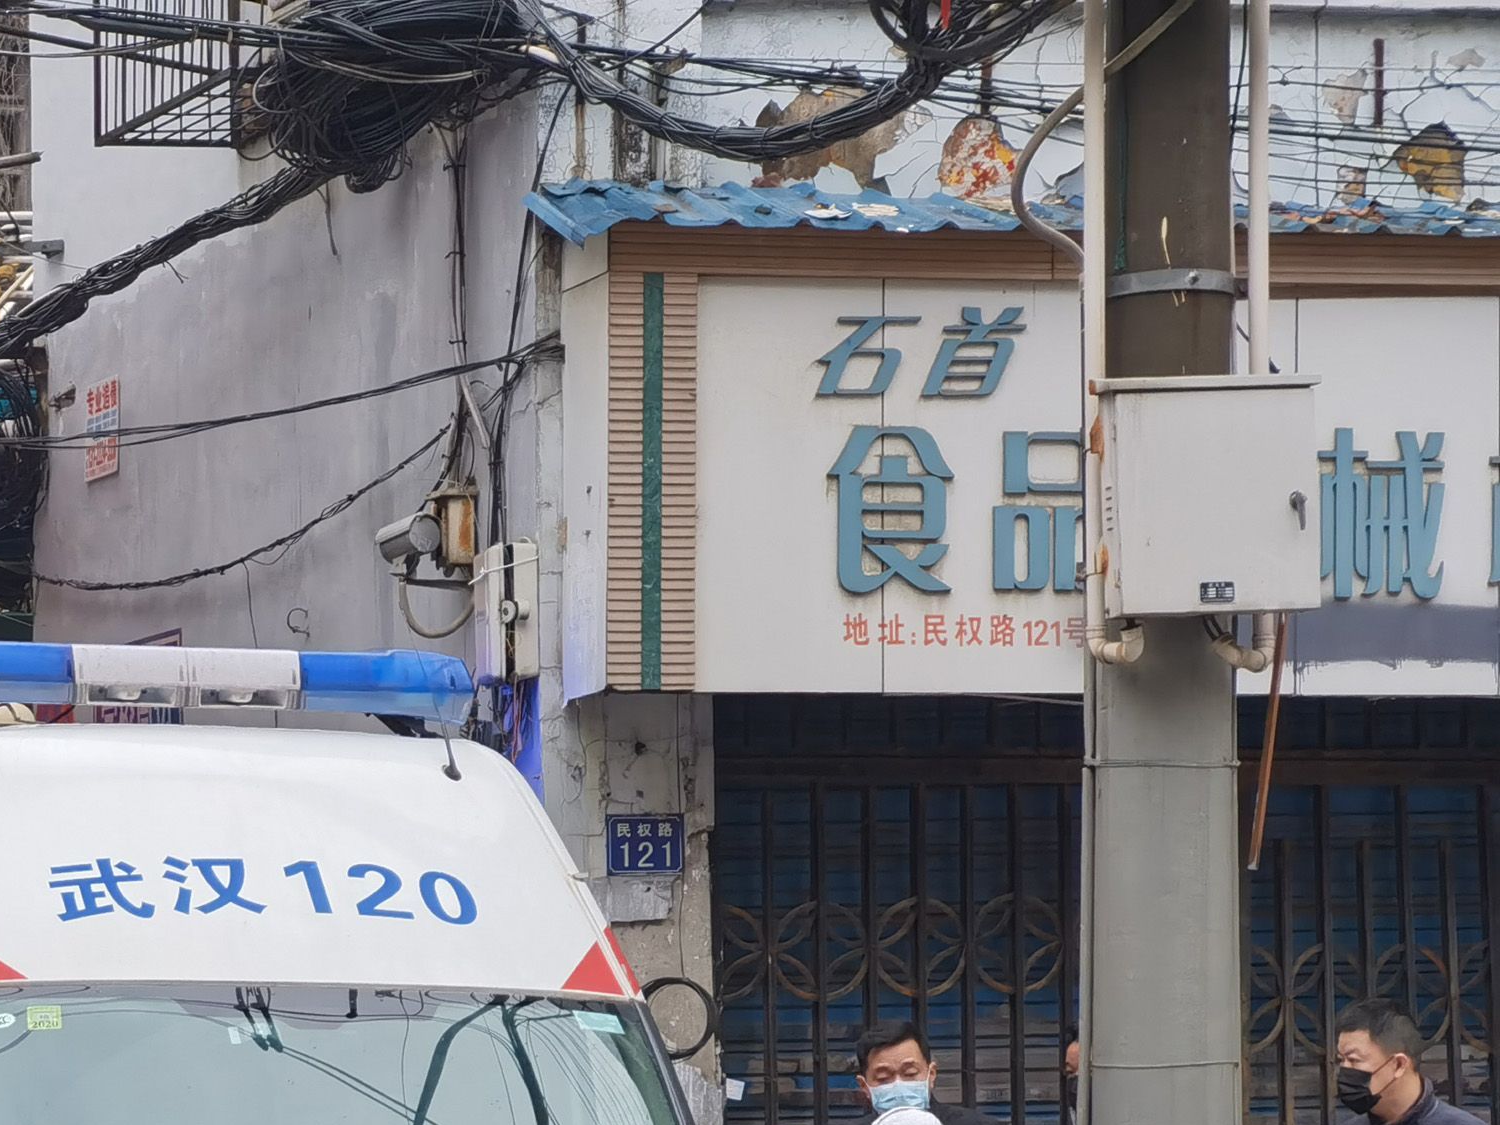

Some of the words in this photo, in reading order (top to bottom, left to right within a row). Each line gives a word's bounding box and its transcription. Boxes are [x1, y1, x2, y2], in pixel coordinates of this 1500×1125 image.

[814, 306, 1028, 397] 石首
[616, 823, 673, 838] 民权路
[619, 841, 672, 868] 121
[31, 1020, 59, 1029] 2020
